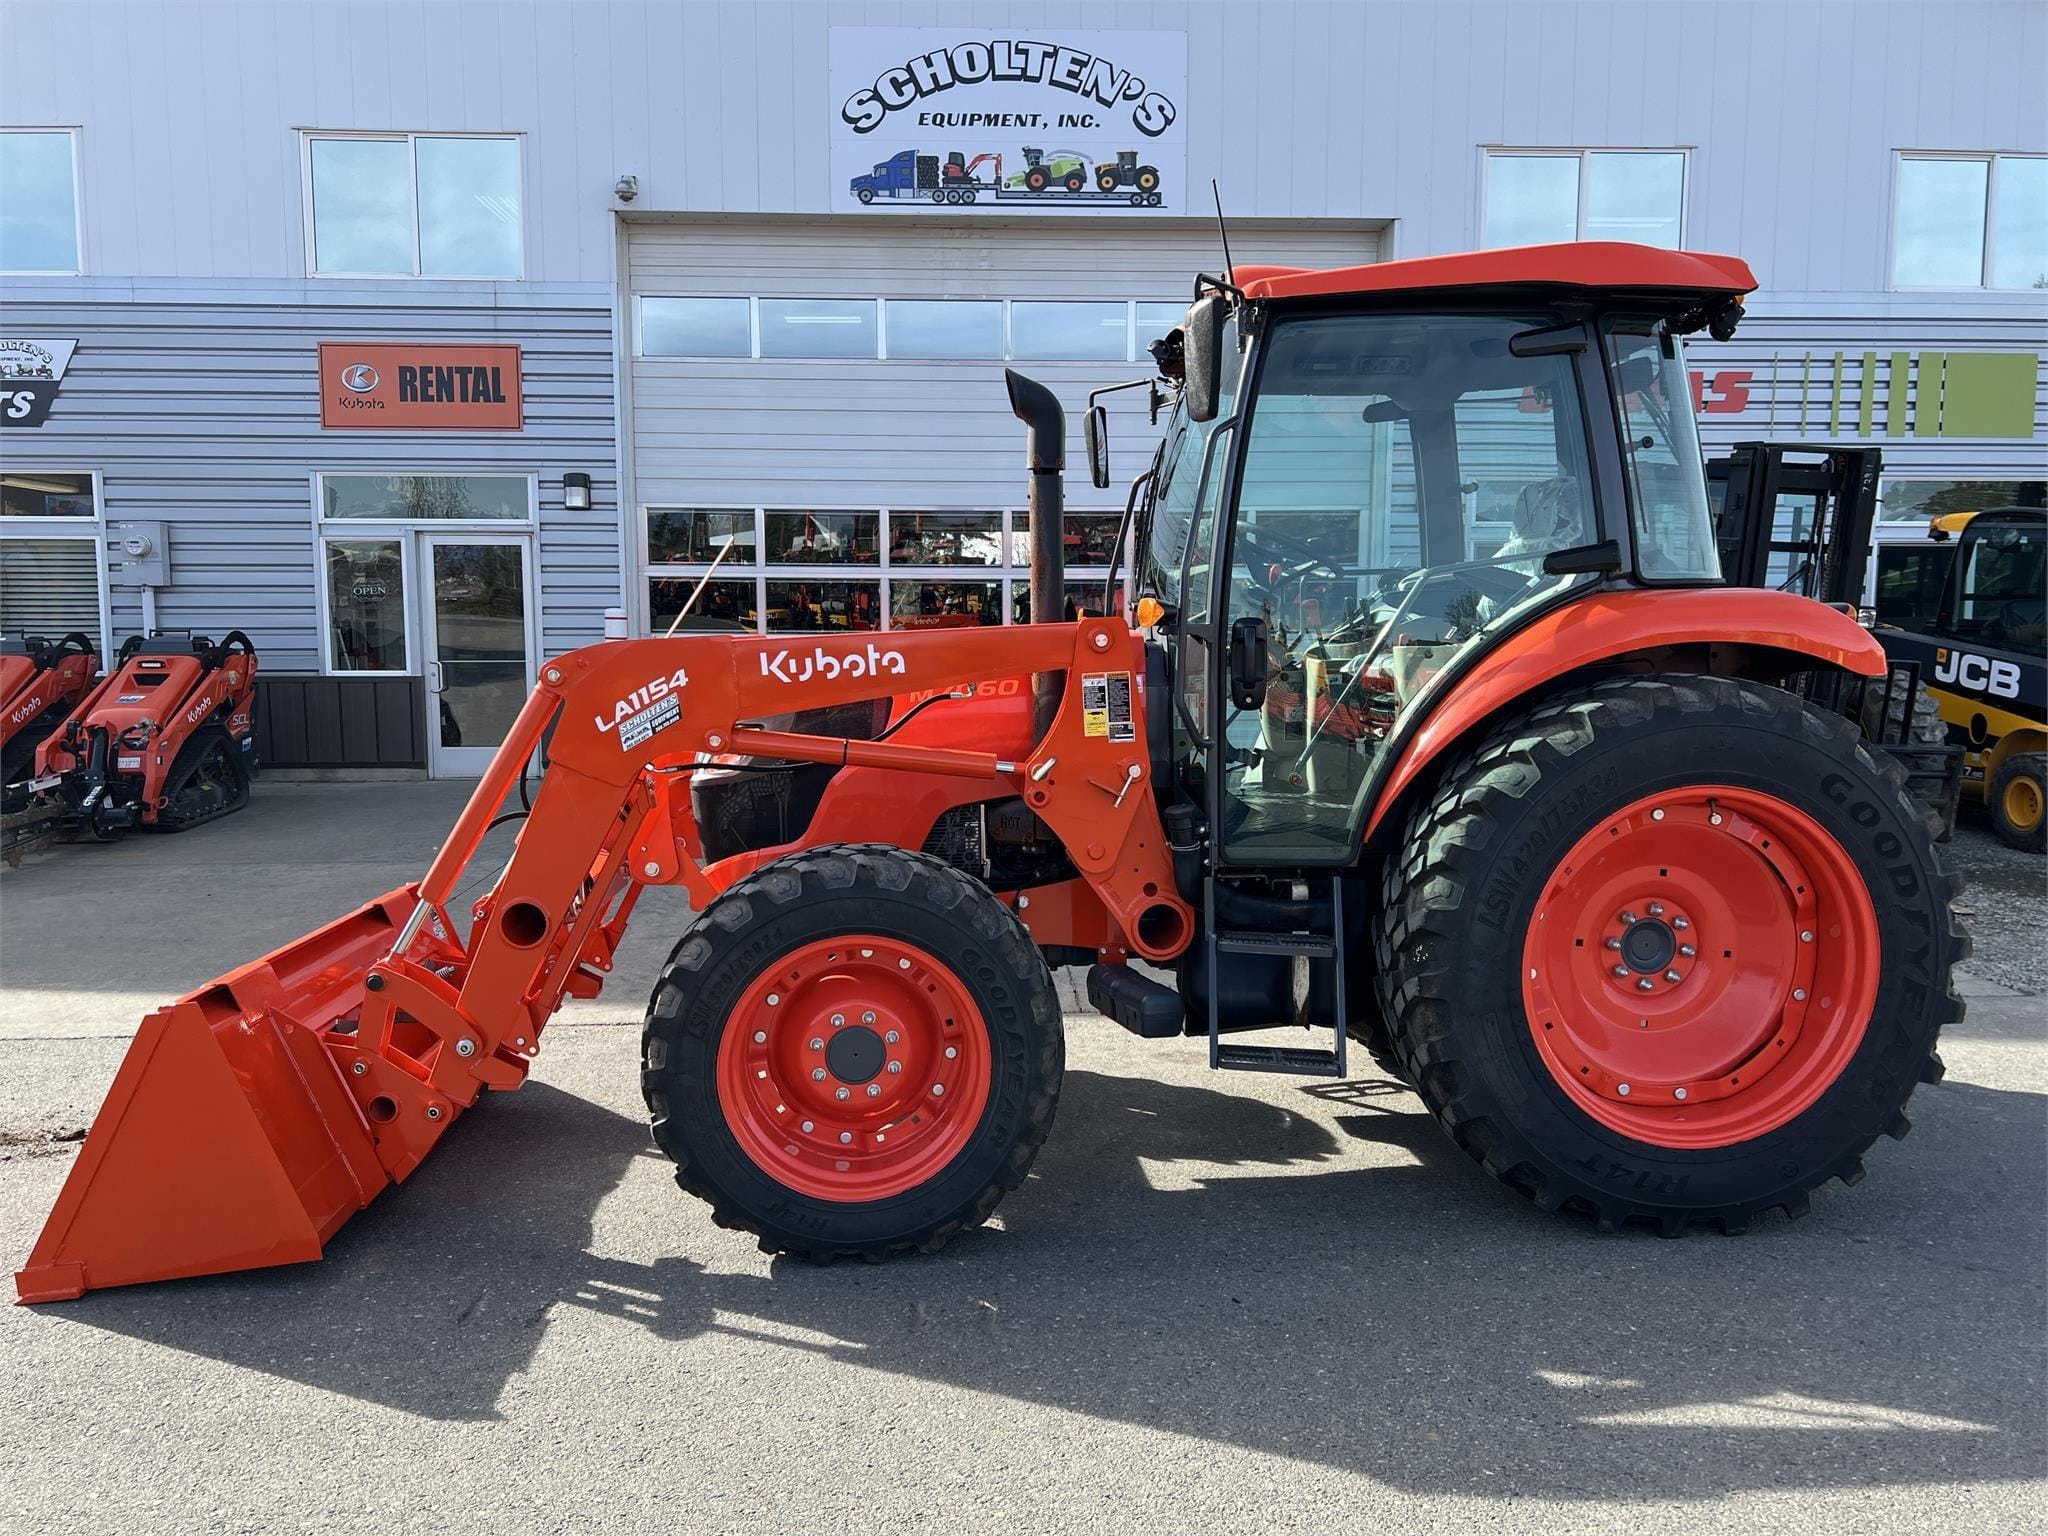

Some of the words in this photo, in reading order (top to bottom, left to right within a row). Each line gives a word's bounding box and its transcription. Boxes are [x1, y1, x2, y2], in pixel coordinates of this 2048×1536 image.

[841, 40, 1176, 138] SCHOLTEN'S
[918, 112, 1048, 130] EQUIPMENT,
[1058, 114, 1101, 128] INC.
[338, 397, 385, 409] Kubota
[398, 365, 506, 403] RENTAL
[353, 586, 386, 596] OPEN
[760, 644, 906, 683] Kubota
[1935, 651, 2021, 698] JCB
[11, 697, 41, 724] Kubota
[187, 697, 211, 723] Kubota
[595, 668, 689, 733] LA1154
[620, 695, 678, 735] SCHOLTEN'S
